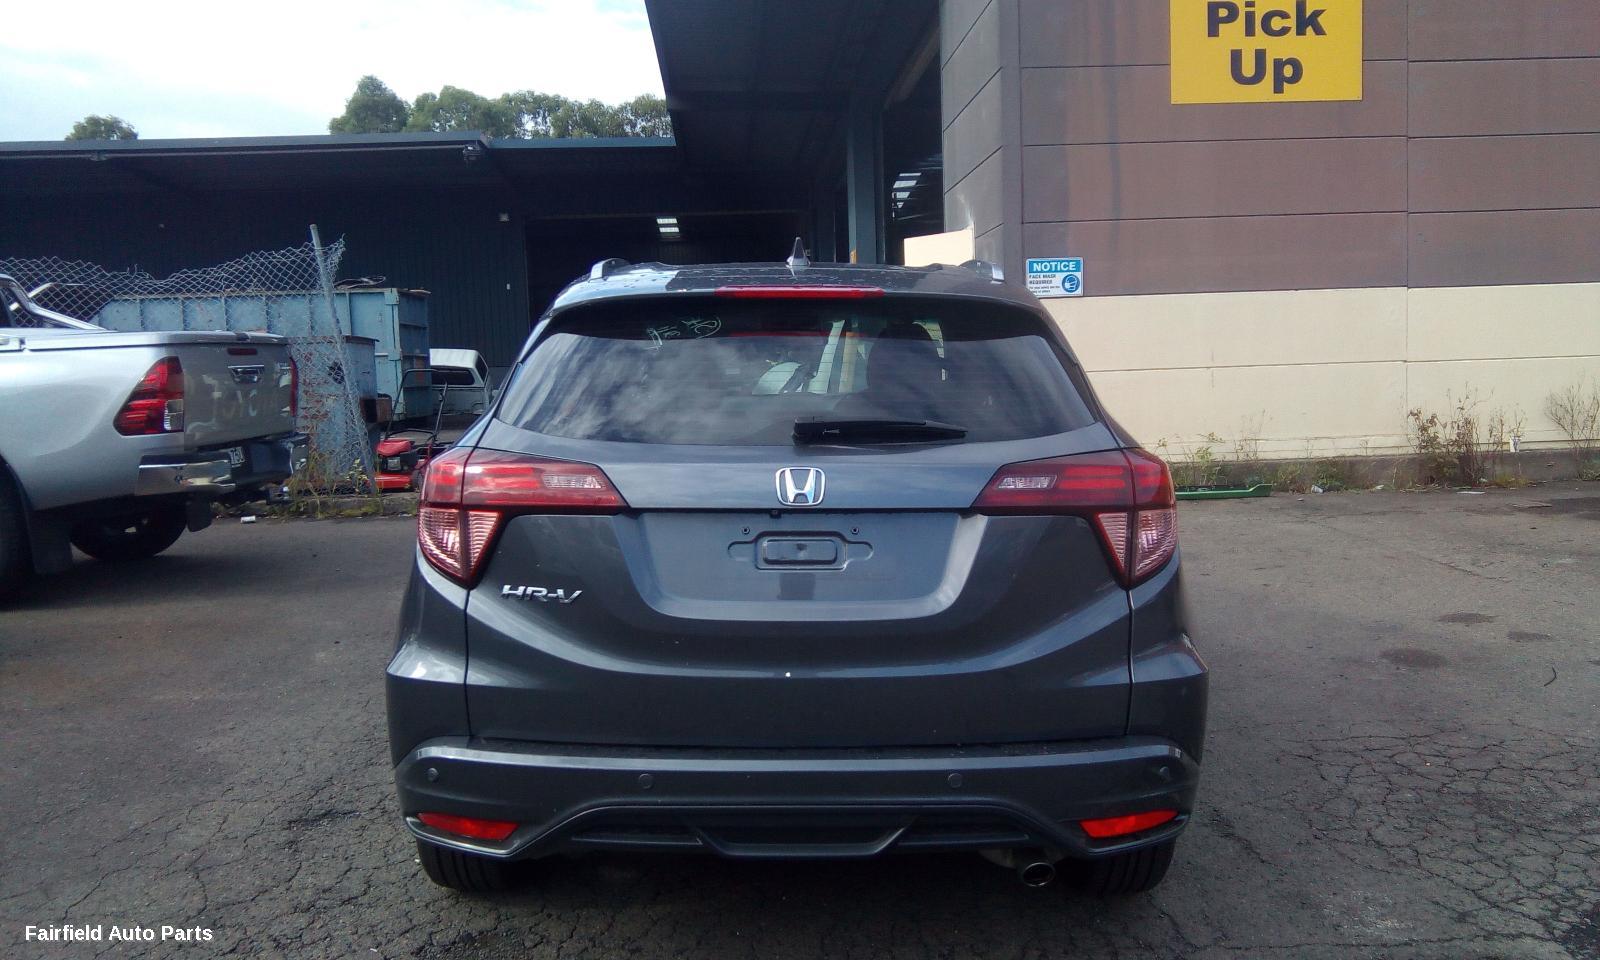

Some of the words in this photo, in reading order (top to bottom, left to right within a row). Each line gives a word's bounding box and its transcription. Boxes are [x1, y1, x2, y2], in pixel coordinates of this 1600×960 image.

[1207, 0, 1328, 38] Pick
[1230, 48, 1304, 95] Up
[1033, 262, 1076, 271] NOTICE
[502, 584, 583, 604] HR-V
